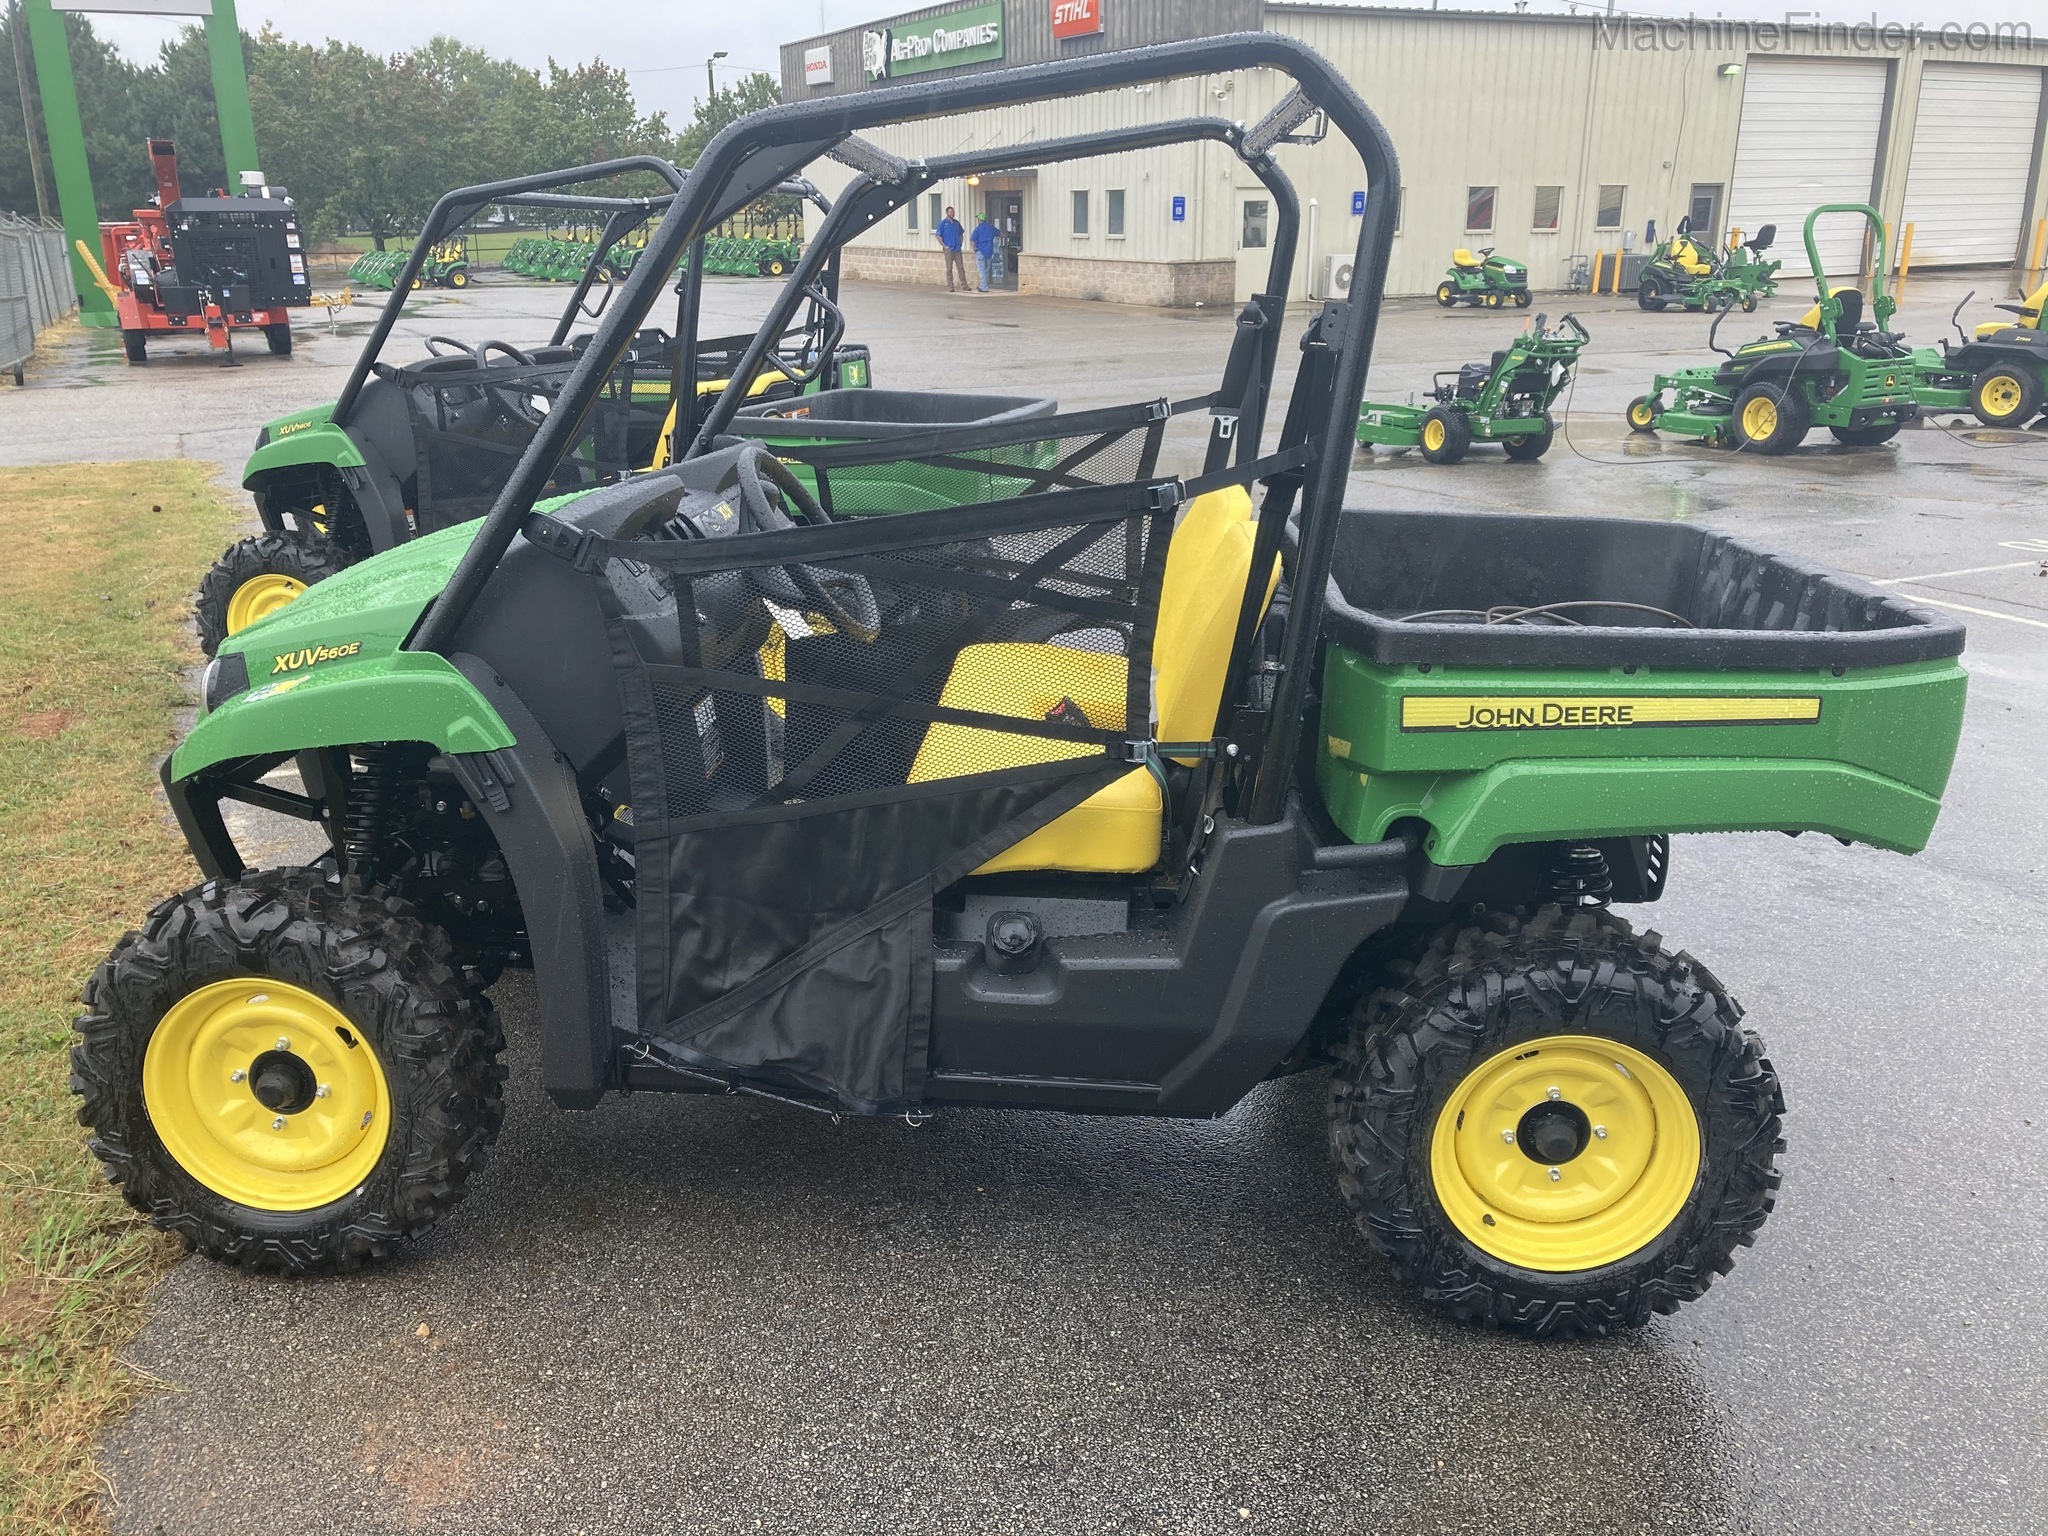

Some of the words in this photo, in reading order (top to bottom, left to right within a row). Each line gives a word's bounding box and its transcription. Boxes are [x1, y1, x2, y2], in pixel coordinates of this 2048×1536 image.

[1053, 0, 1091, 25] STIHL
[933, 22, 999, 54] COMPANIES
[805, 60, 828, 72] HONDA
[278, 421, 313, 436] XUV560E
[271, 641, 361, 675] XUV560E
[1458, 704, 1535, 727] JOHN
[1542, 703, 1634, 724] DEERE
